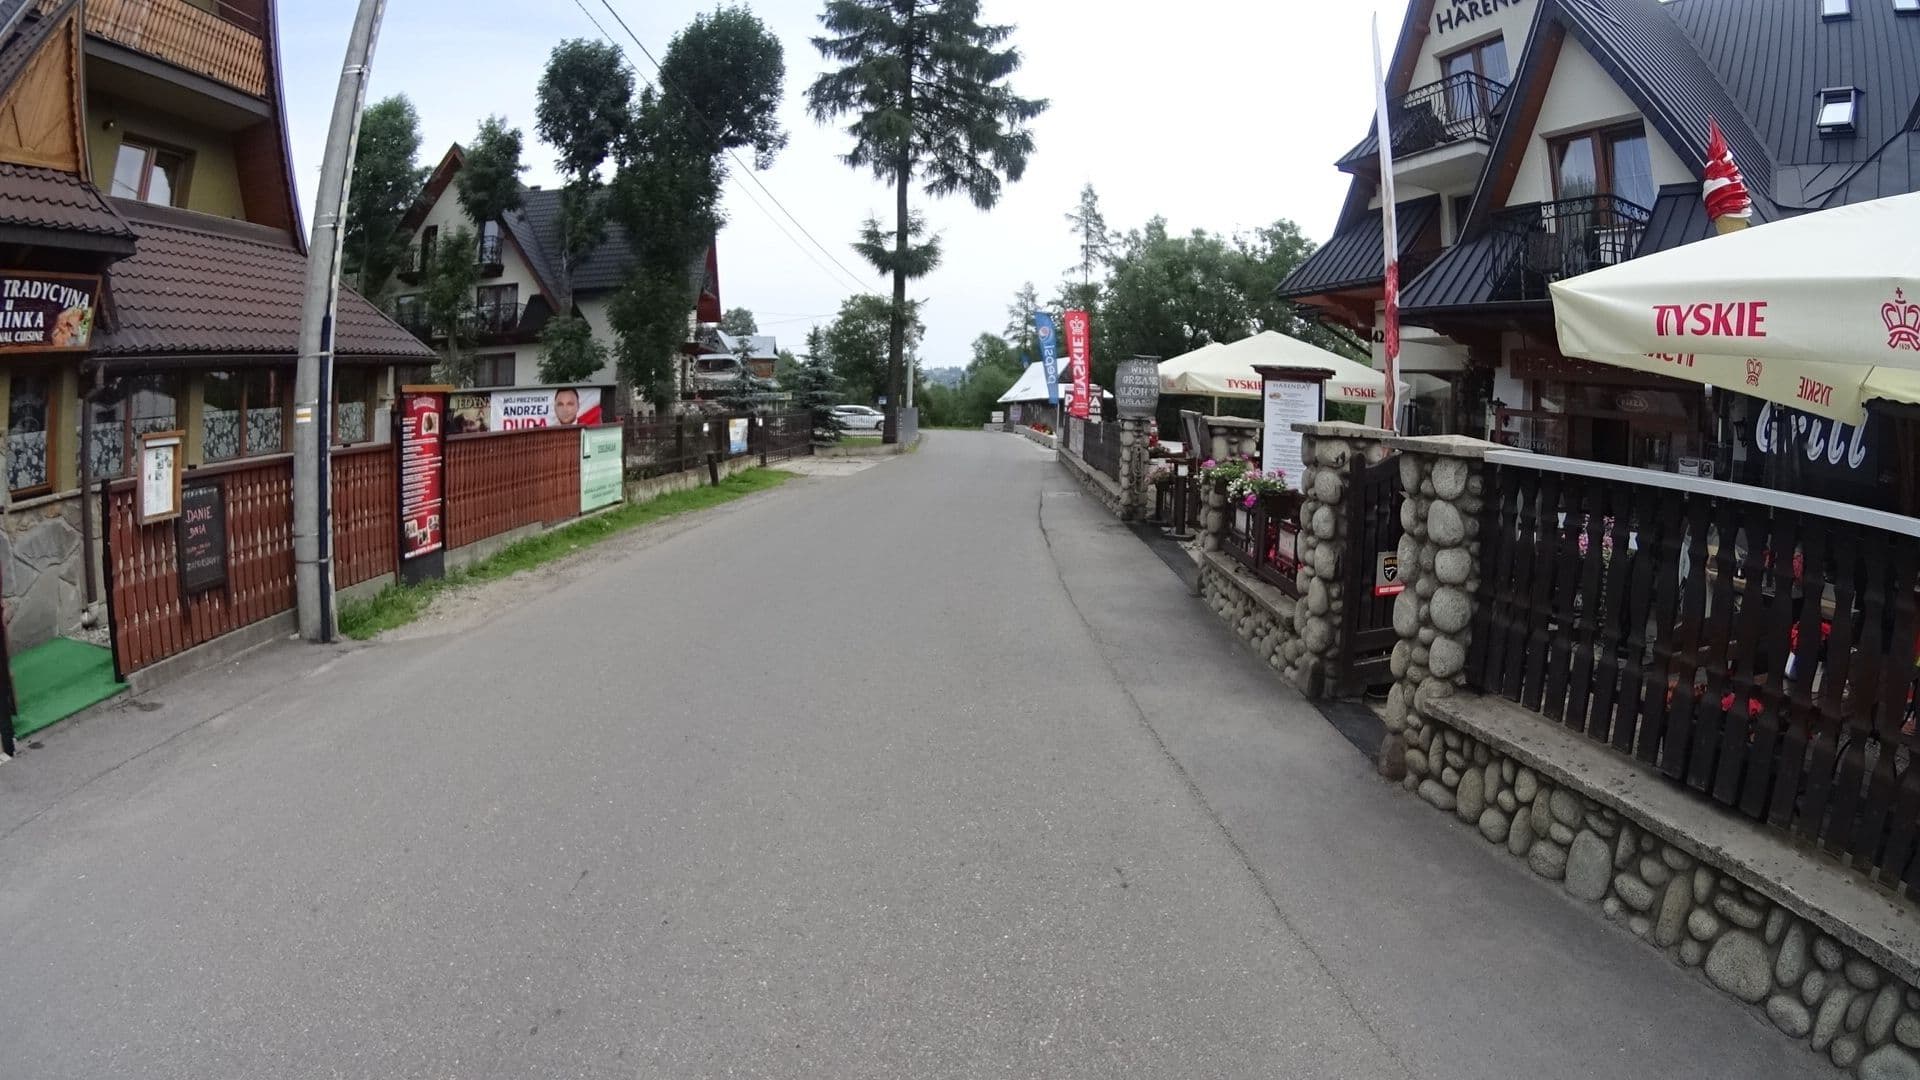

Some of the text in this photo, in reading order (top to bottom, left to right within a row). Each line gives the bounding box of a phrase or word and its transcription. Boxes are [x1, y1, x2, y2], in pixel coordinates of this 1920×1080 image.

[1436, 0, 1523, 34] HAREN
[4, 280, 90, 310] TRADYCYJNA
[1653, 301, 1768, 337] TYSKIE
[15, 331, 45, 342] CUISINE
[1342, 386, 1377, 398] TYSKIE
[503, 405, 549, 416] ANDRZEJ
[185, 506, 213, 524] DANIE
